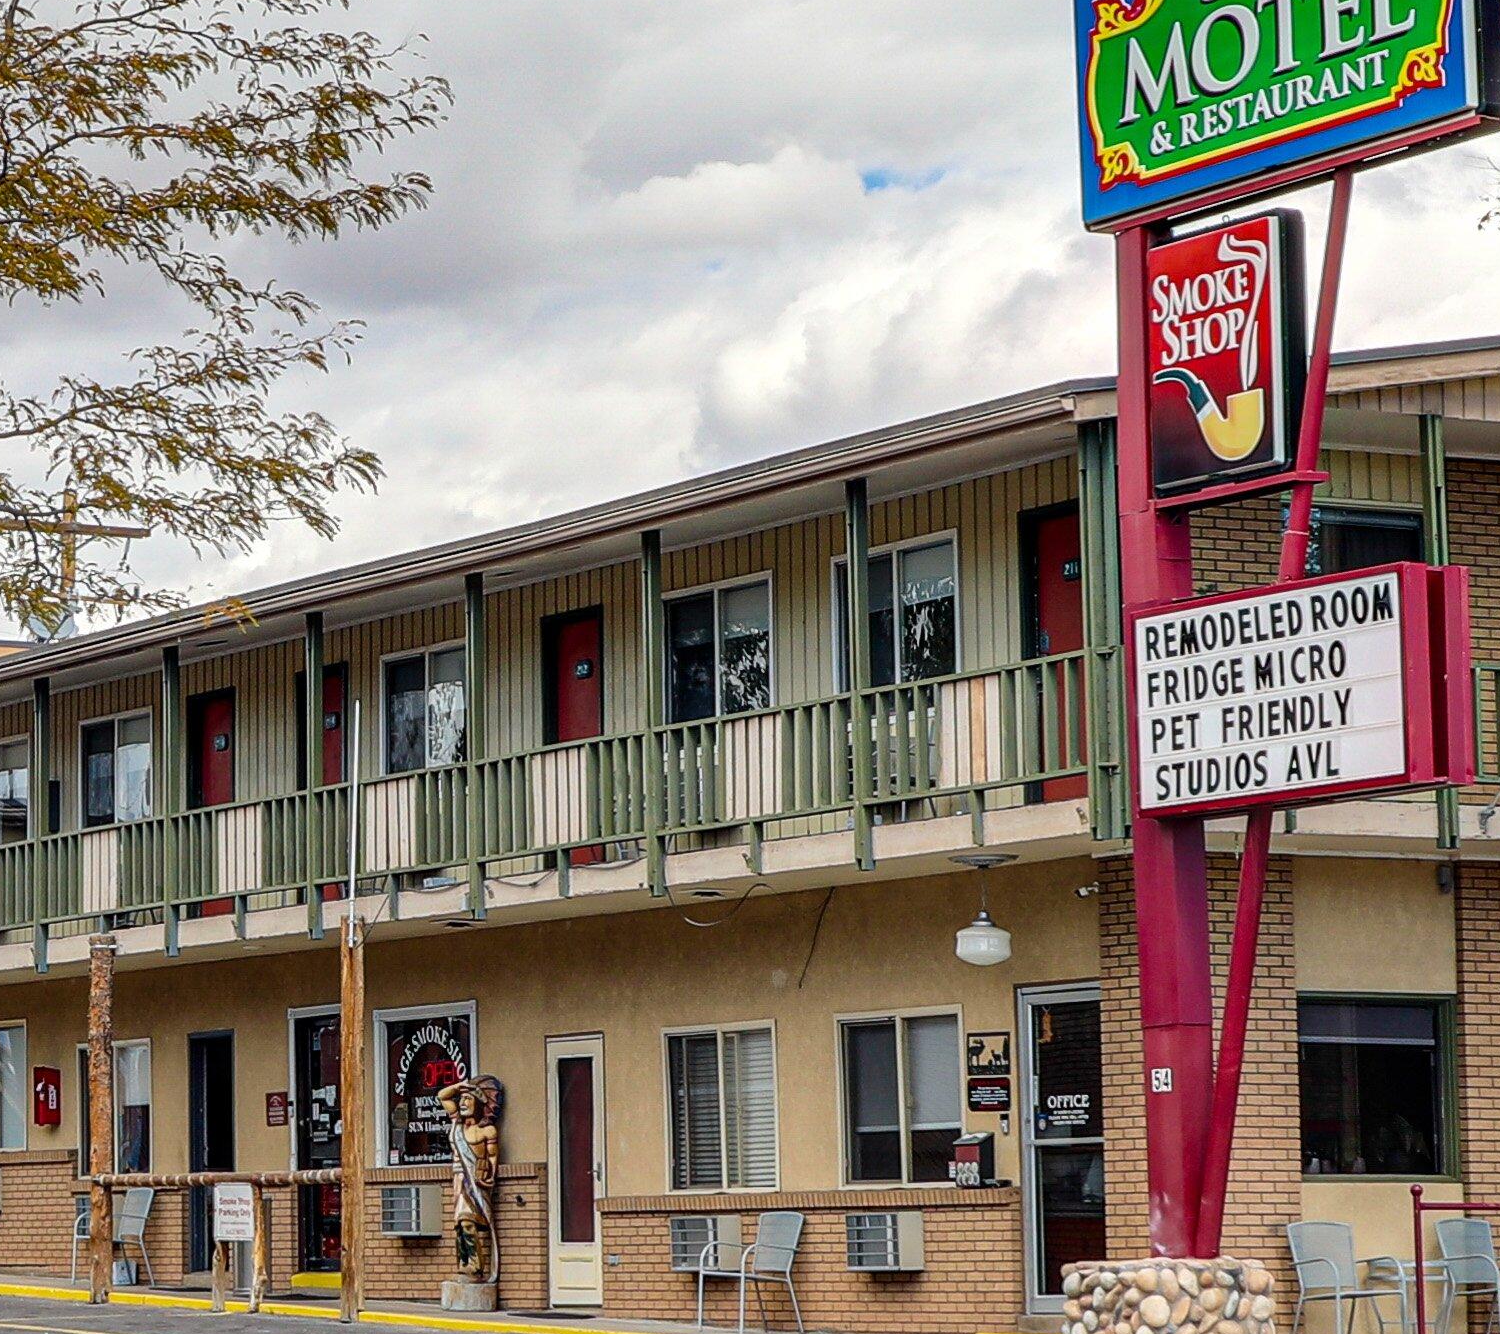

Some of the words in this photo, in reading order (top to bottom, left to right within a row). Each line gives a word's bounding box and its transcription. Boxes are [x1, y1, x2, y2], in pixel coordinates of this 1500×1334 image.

[1149, 121, 1175, 156] &
[1179, 49, 1390, 147] RESTAURANT
[1152, 263, 1250, 323] SMOKE
[1161, 308, 1246, 366] SHOP
[1145, 600, 1303, 661] REMODELED
[1310, 581, 1394, 632] ROOM
[1147, 658, 1245, 707] FRIDGE
[1254, 640, 1347, 692] MICRO
[1151, 712, 1200, 754] PET
[1221, 687, 1352, 745] FRIENDLY
[1156, 749, 1269, 801] STUDIOS
[1286, 741, 1340, 782] AVL
[395, 1044, 415, 1096] SAGE
[412, 1024, 449, 1050] SMOKE
[446, 1038, 467, 1080] SHO
[1153, 1069, 1171, 1091] 54
[1047, 1094, 1091, 1109] OFFICE
